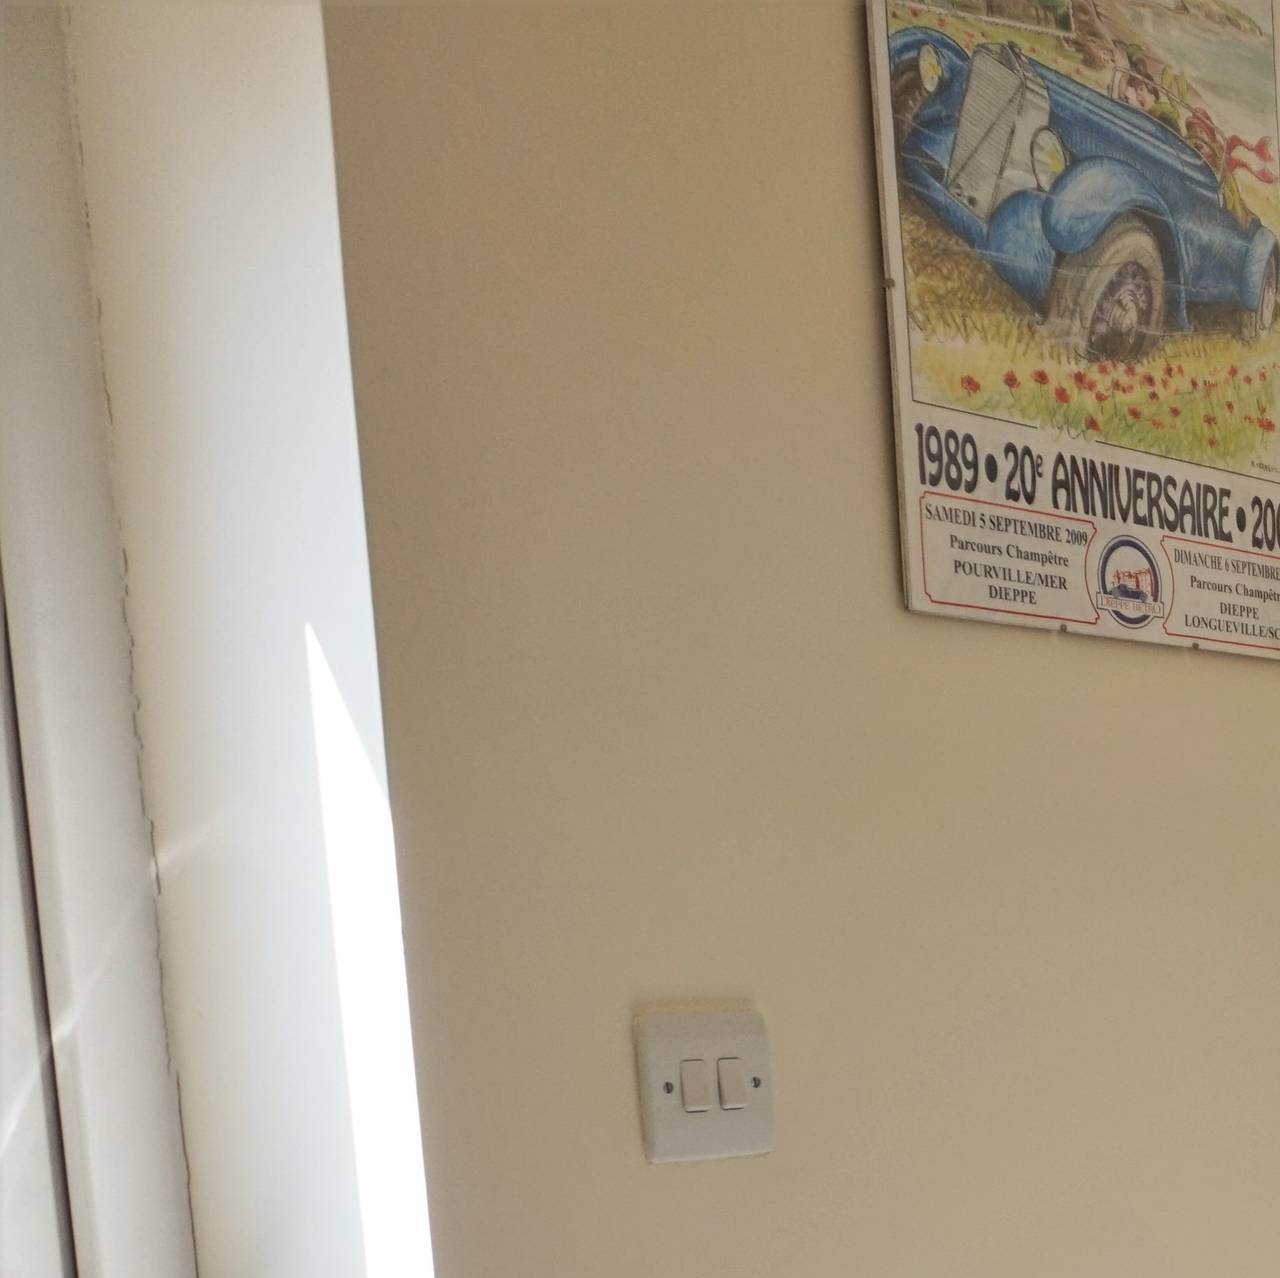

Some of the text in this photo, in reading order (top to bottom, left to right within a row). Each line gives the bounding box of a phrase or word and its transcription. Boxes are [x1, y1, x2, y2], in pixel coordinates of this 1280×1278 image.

[915, 422, 979, 494] 1989
[1051, 451, 1234, 543] ANNIVERSAIRE
[925, 503, 1088, 547] SAMEDI 5 SEPTEMBRE 2009
[950, 534, 1069, 568] Parcours Champêtre
[1174, 548, 1222, 572] DIMANCHE
[1224, 559, 1230, 571] 6
[1230, 559, 1280, 582] SEPTEMBRE
[953, 560, 1068, 590] POURVILLE/MER
[1190, 575, 1233, 594] Parcours
[988, 585, 1037, 605] DIEPPE
[1219, 602, 1260, 620] DIEPPE
